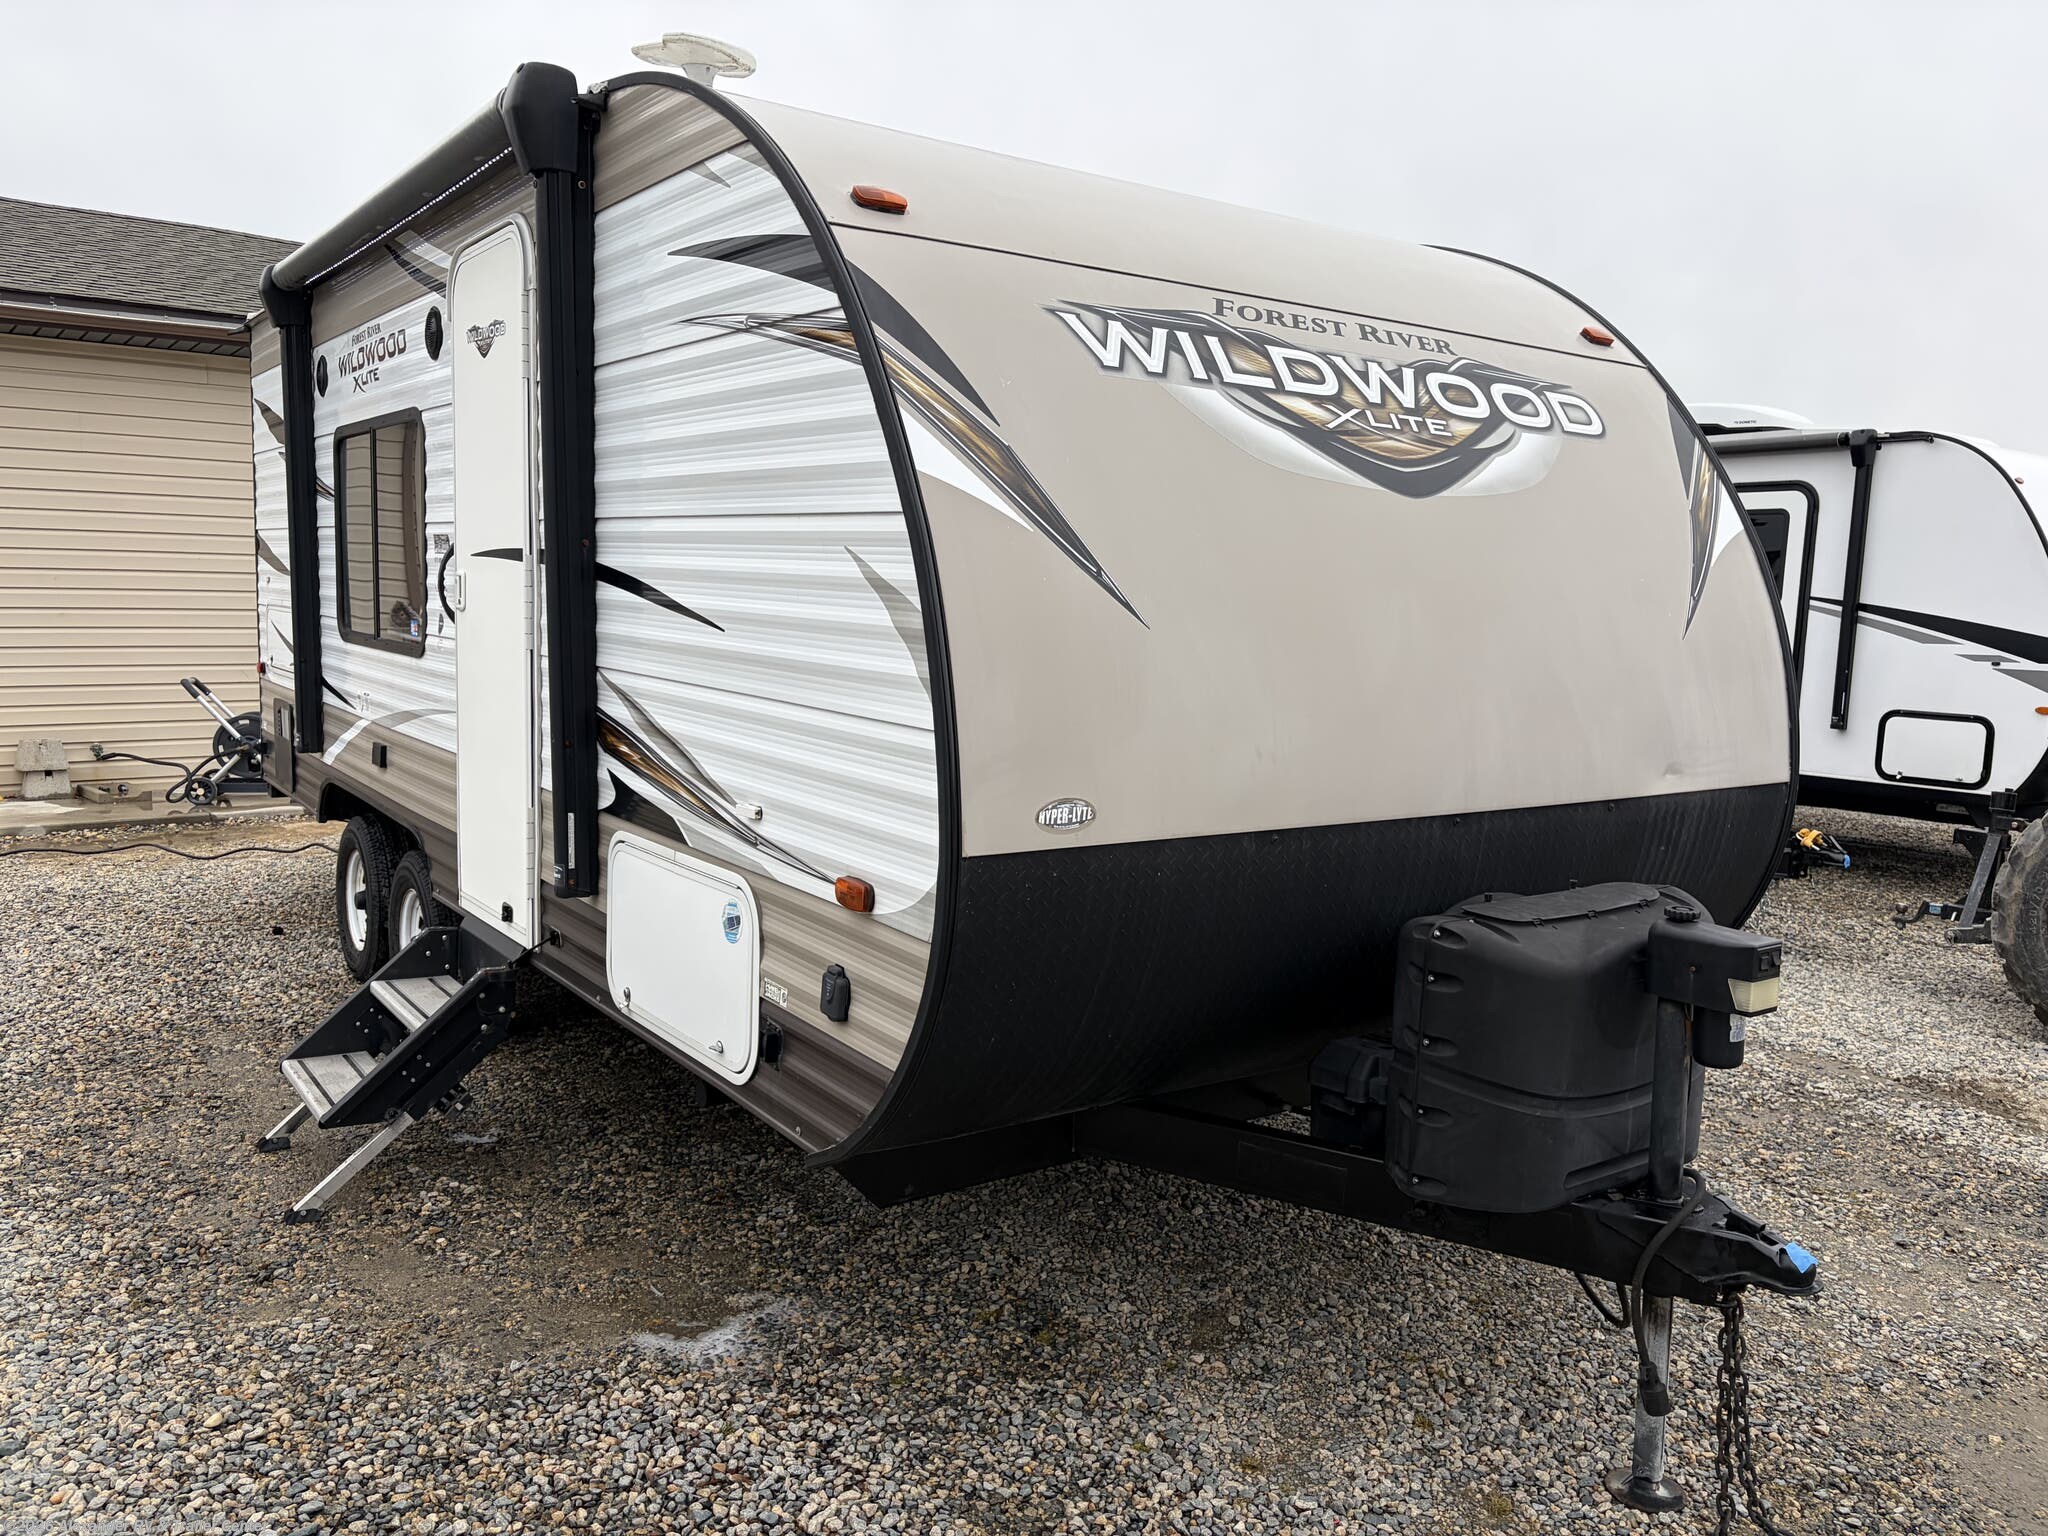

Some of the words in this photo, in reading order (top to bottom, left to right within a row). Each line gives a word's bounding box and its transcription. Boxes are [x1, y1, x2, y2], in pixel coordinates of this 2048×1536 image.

[351, 329, 366, 346] FOREST
[367, 323, 381, 338] RIVER
[1211, 297, 1346, 337] FOREST
[1353, 321, 1457, 356] RIVER
[338, 328, 407, 378] WILDWOOD
[1050, 310, 1604, 436] WILDWOOD
[1038, 806, 1094, 825] HYPER-LYTE
